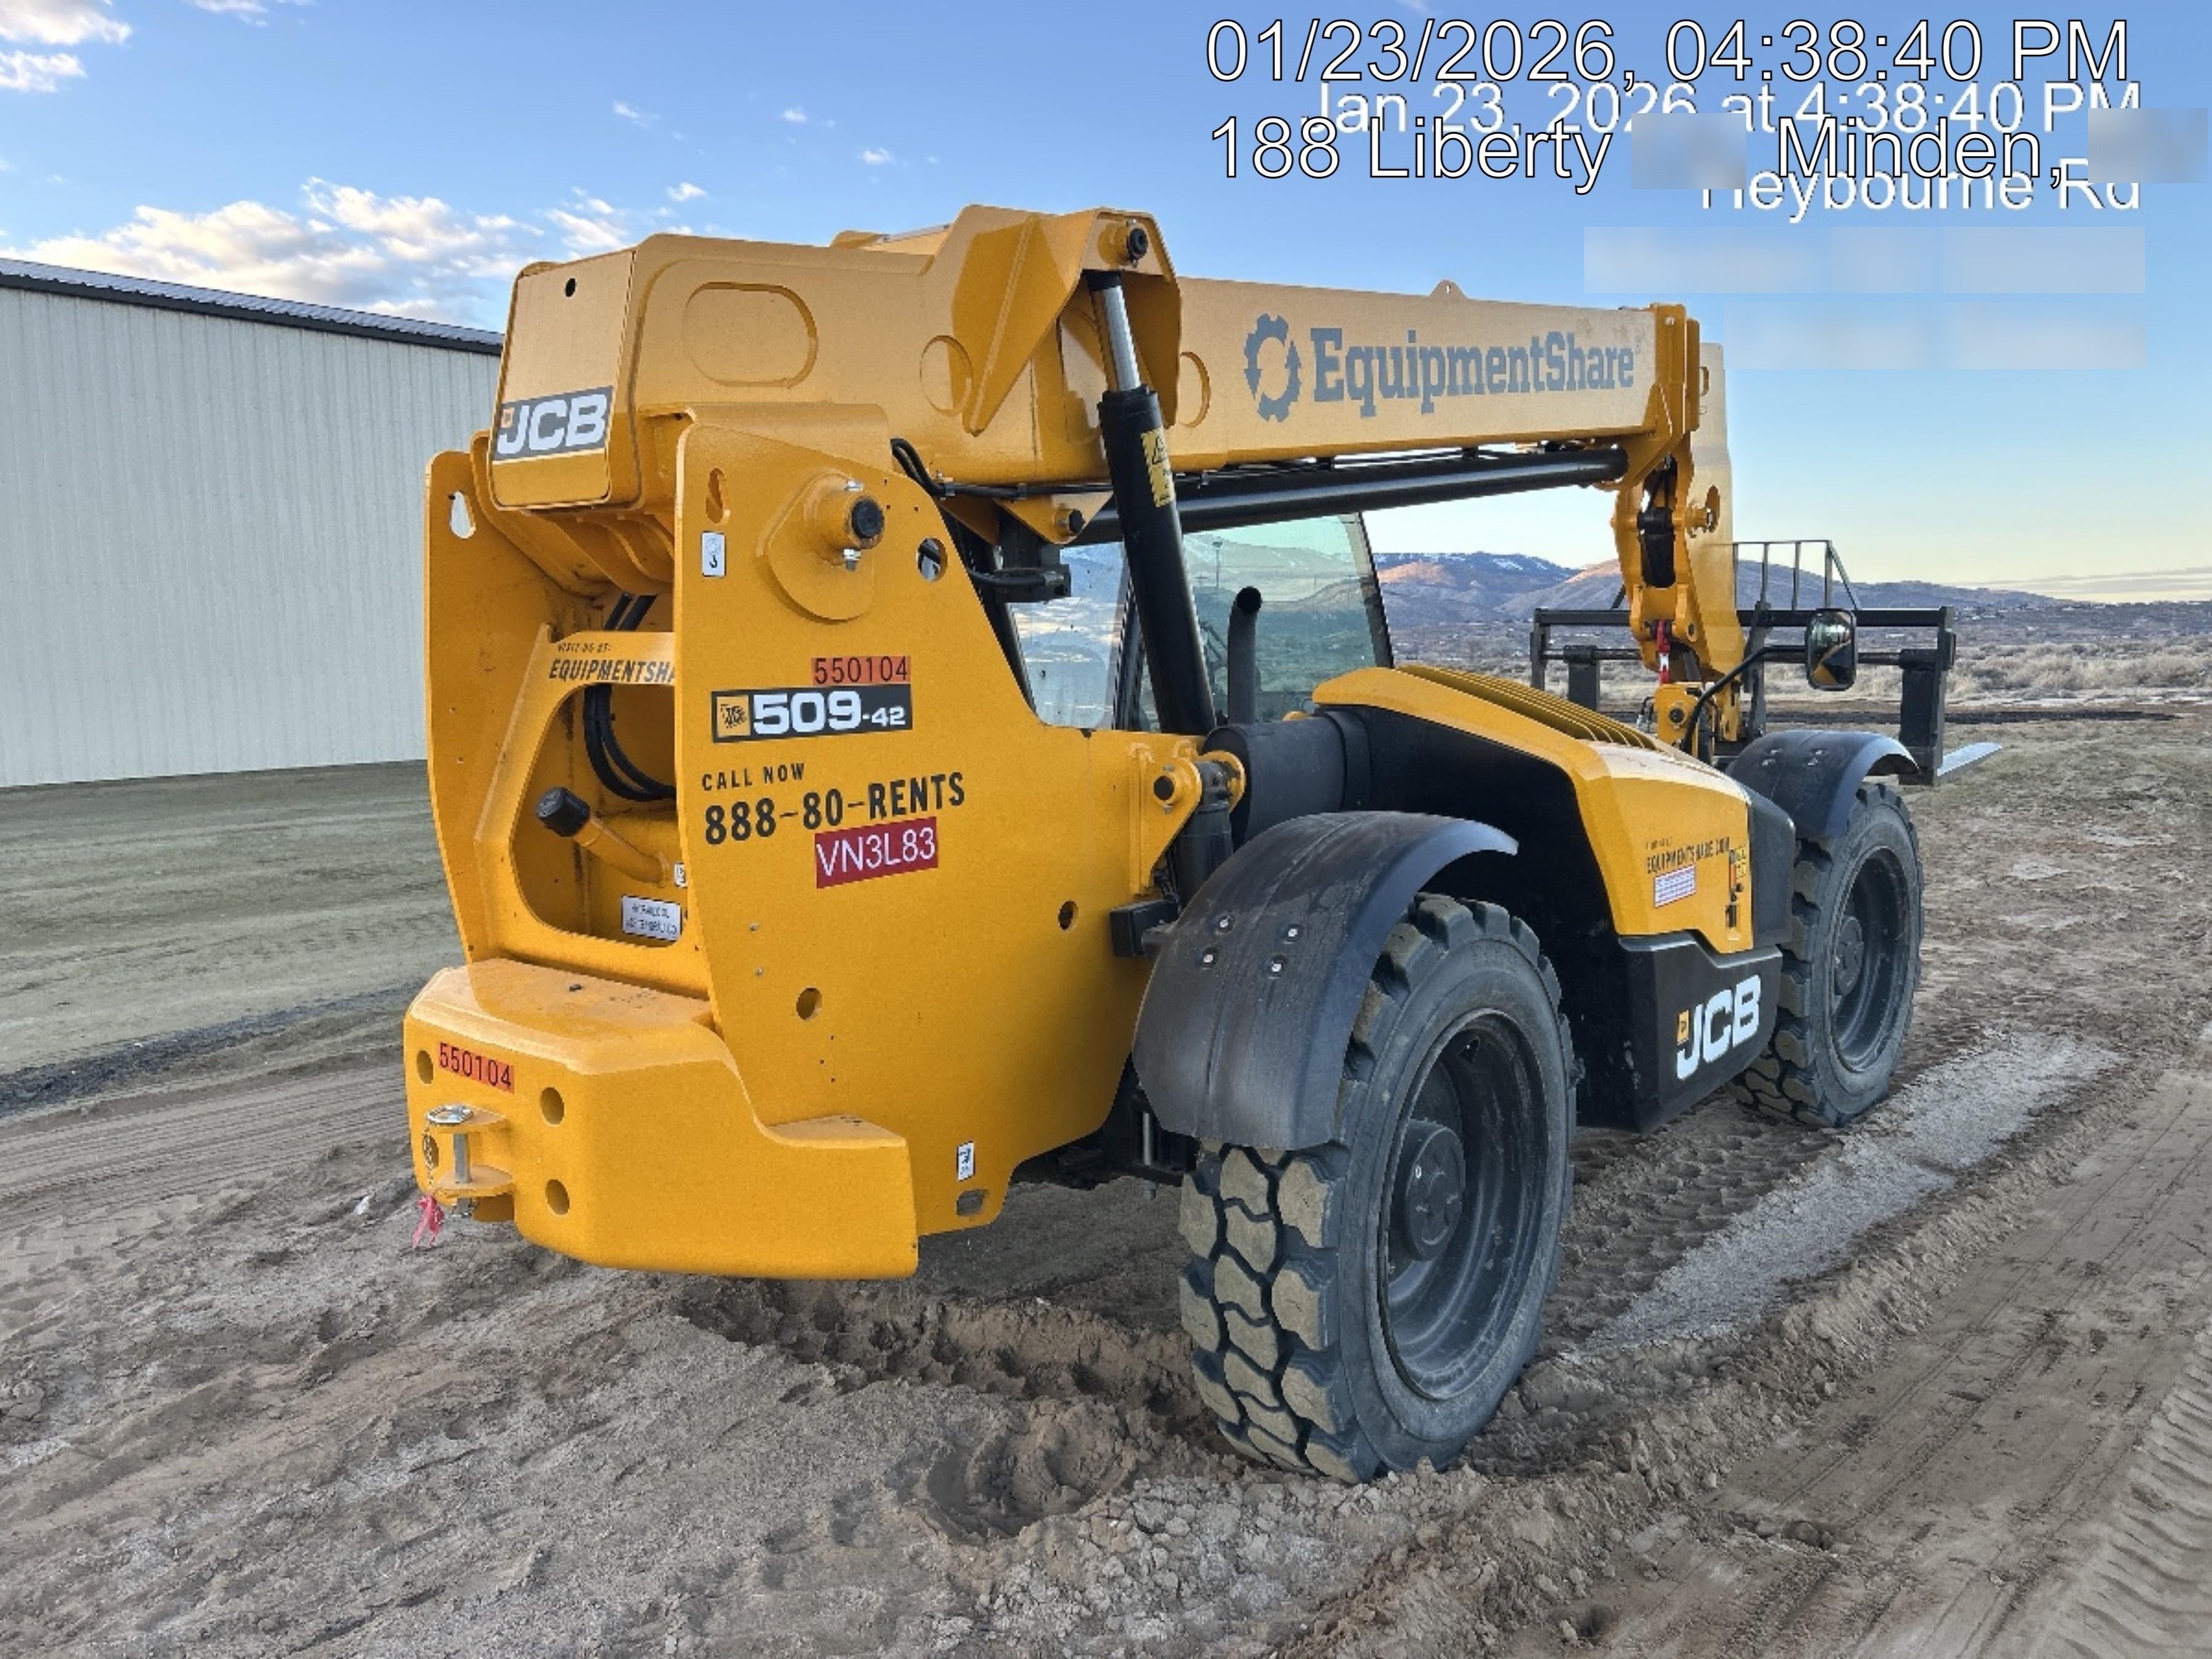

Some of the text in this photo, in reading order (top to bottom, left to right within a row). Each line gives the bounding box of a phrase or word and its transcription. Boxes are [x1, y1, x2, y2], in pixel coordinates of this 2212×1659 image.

[1310, 327, 1634, 418] EquipmentShare
[497, 394, 608, 454] JCB
[815, 656, 908, 684] 550104
[753, 691, 906, 734] 509-42
[702, 763, 805, 791] CALL NOW
[705, 772, 965, 845] 888-80-RENTS
[816, 827, 935, 876] VN3L83
[1677, 974, 1761, 1080] JCB
[440, 1041, 511, 1087] 550104
